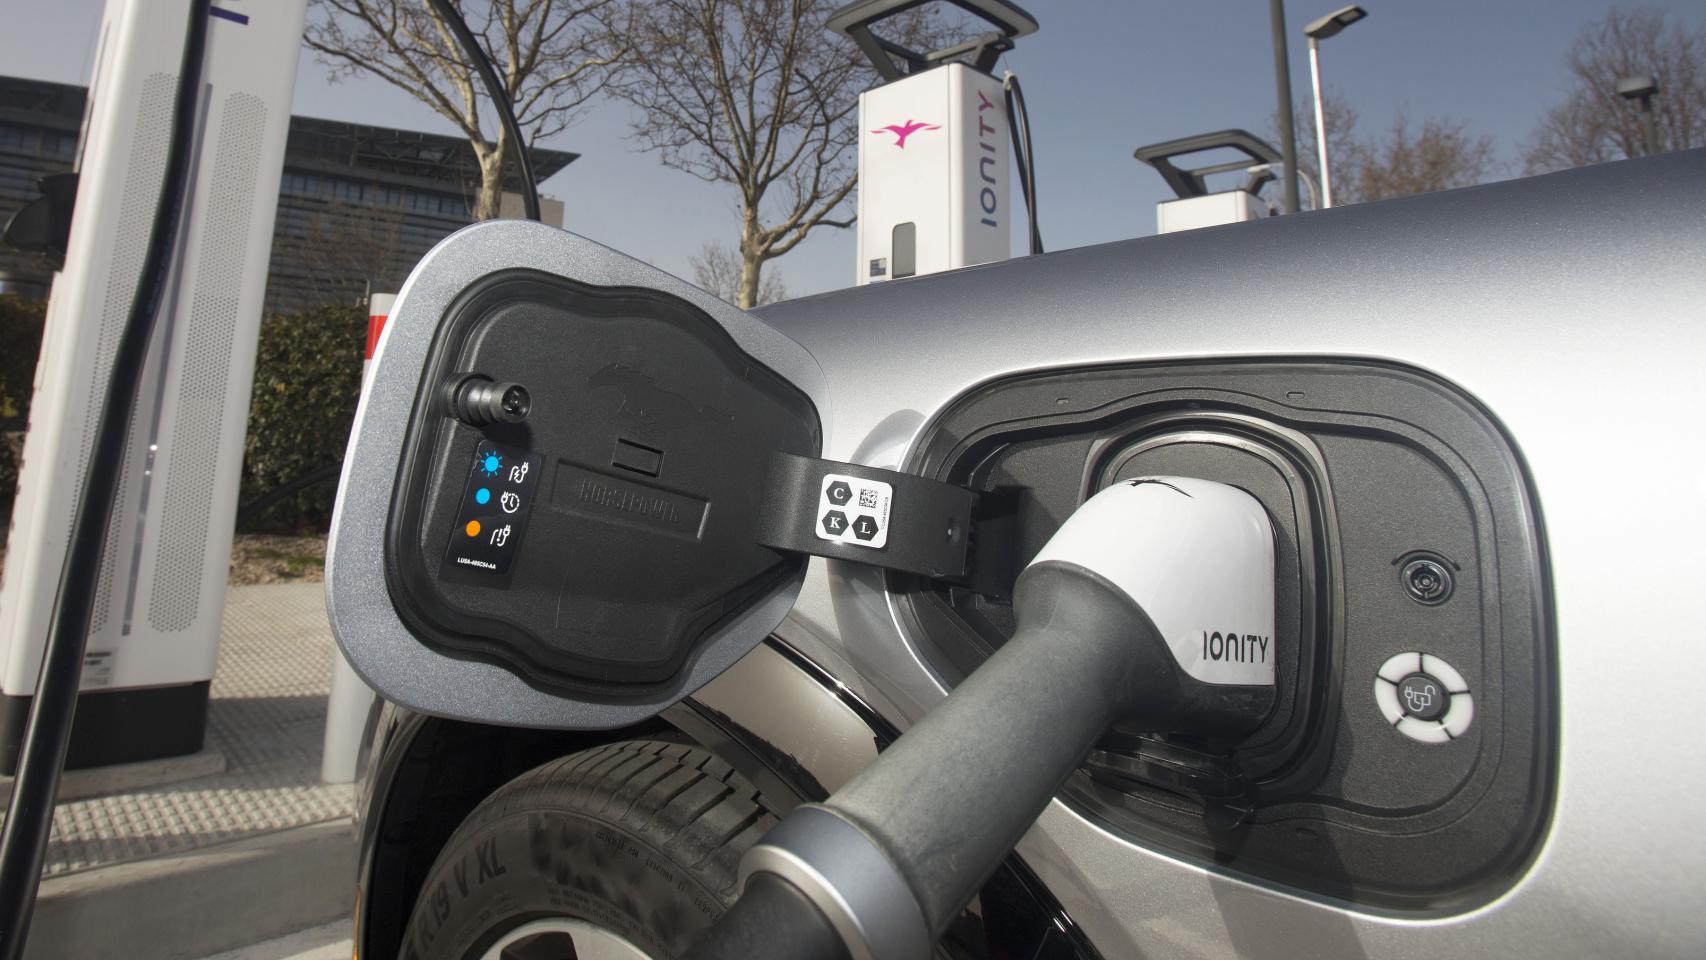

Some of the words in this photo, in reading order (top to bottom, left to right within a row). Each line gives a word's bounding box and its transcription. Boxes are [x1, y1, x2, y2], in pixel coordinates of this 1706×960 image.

[978, 89, 997, 228] IONITY
[833, 488, 844, 499] C
[829, 516, 841, 529] K
[860, 521, 871, 534] L
[1203, 630, 1269, 664] IONITY
[453, 855, 469, 898] V
[475, 836, 506, 884] XL
